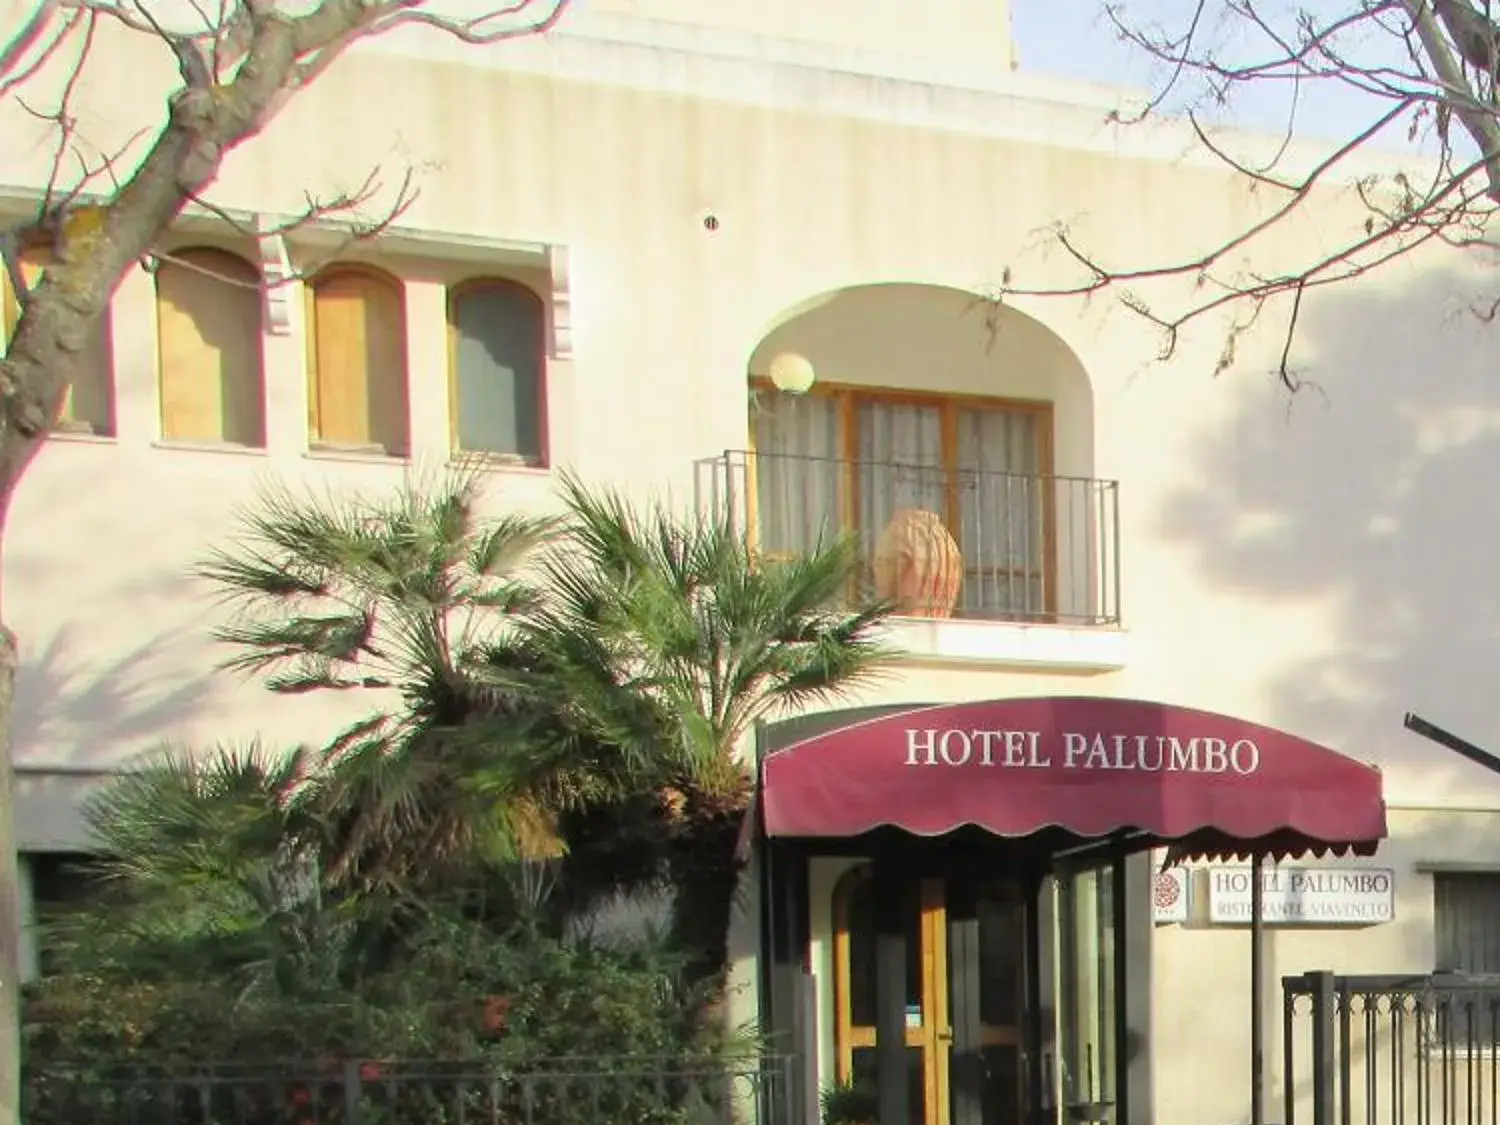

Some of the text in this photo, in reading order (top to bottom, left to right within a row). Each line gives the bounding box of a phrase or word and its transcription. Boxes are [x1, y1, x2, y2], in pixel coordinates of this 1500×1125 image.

[903, 728, 1260, 775] HOTEL PALUMBO
[1215, 873, 1389, 894] HOEL PALUMBO
